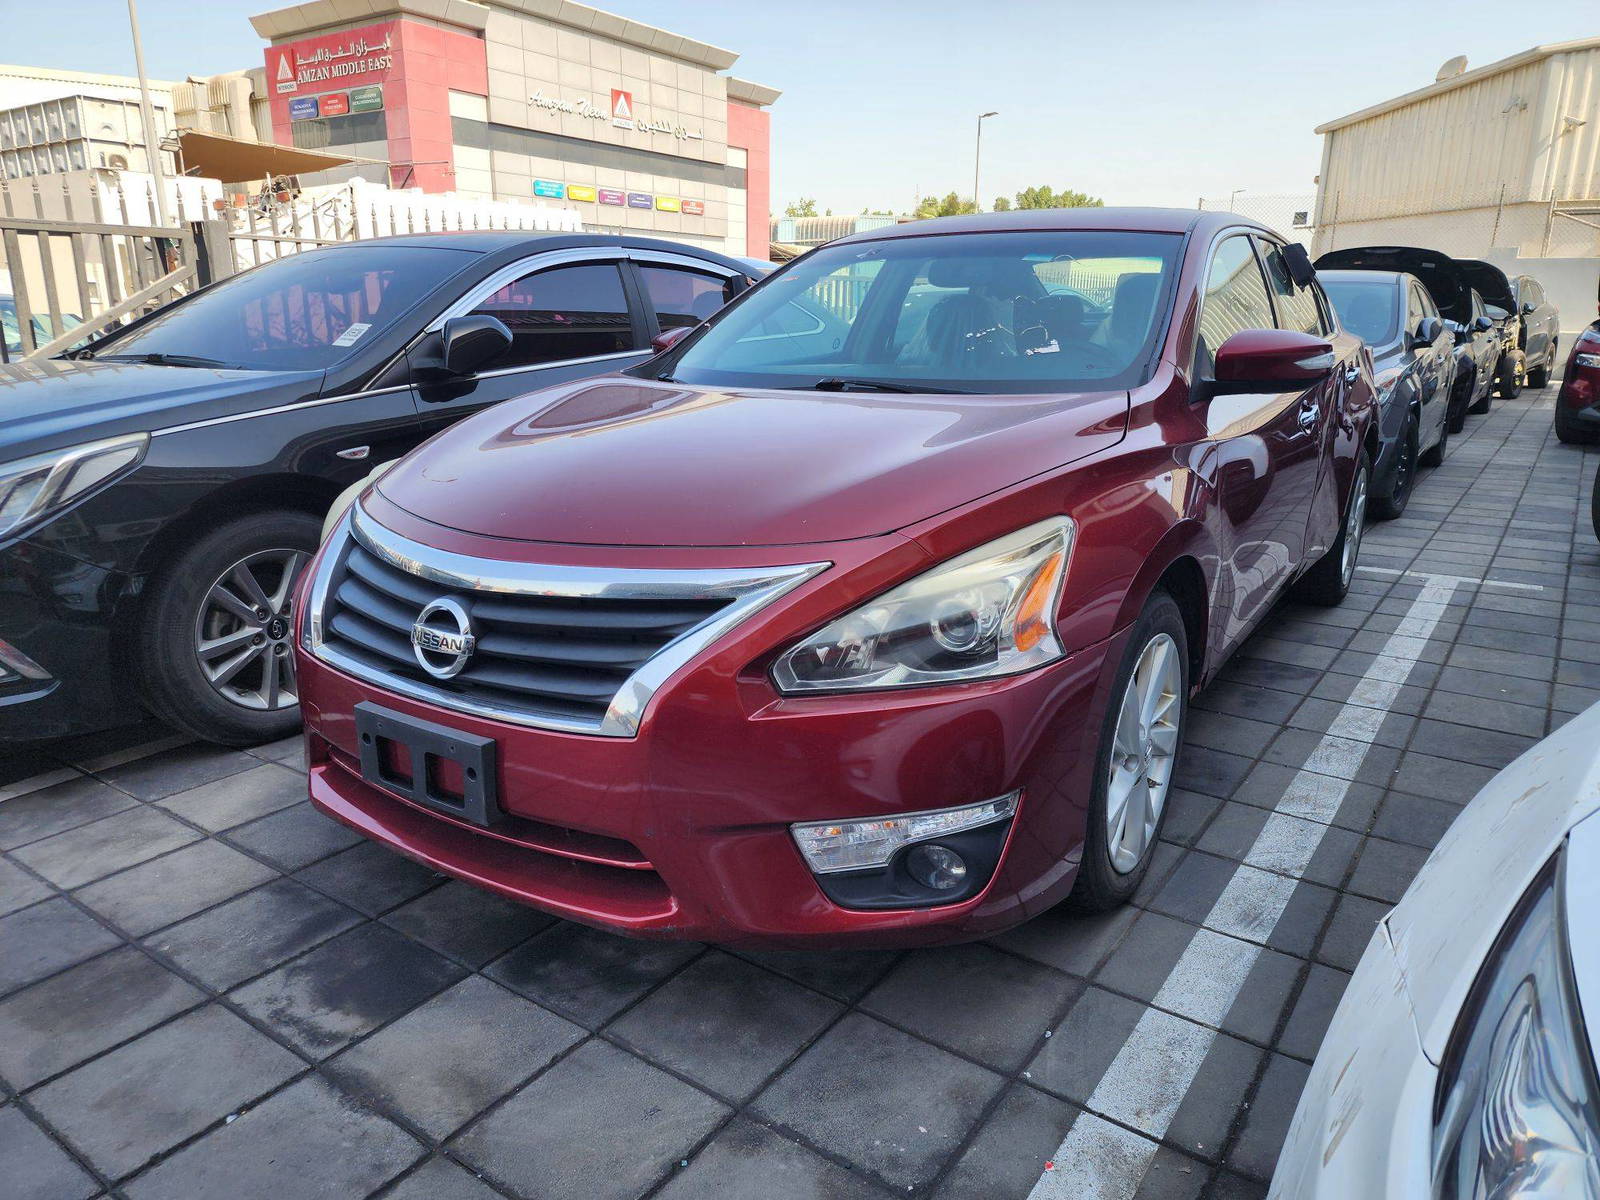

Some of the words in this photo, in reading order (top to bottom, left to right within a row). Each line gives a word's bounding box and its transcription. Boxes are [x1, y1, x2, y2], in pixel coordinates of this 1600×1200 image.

[297, 64, 331, 84] AMZAN
[331, 60, 366, 77] MIDDLE
[367, 55, 392, 71] EAST
[528, 88, 573, 116] Amzan
[576, 97, 607, 121] Neon
[416, 629, 462, 651] NISSAN
